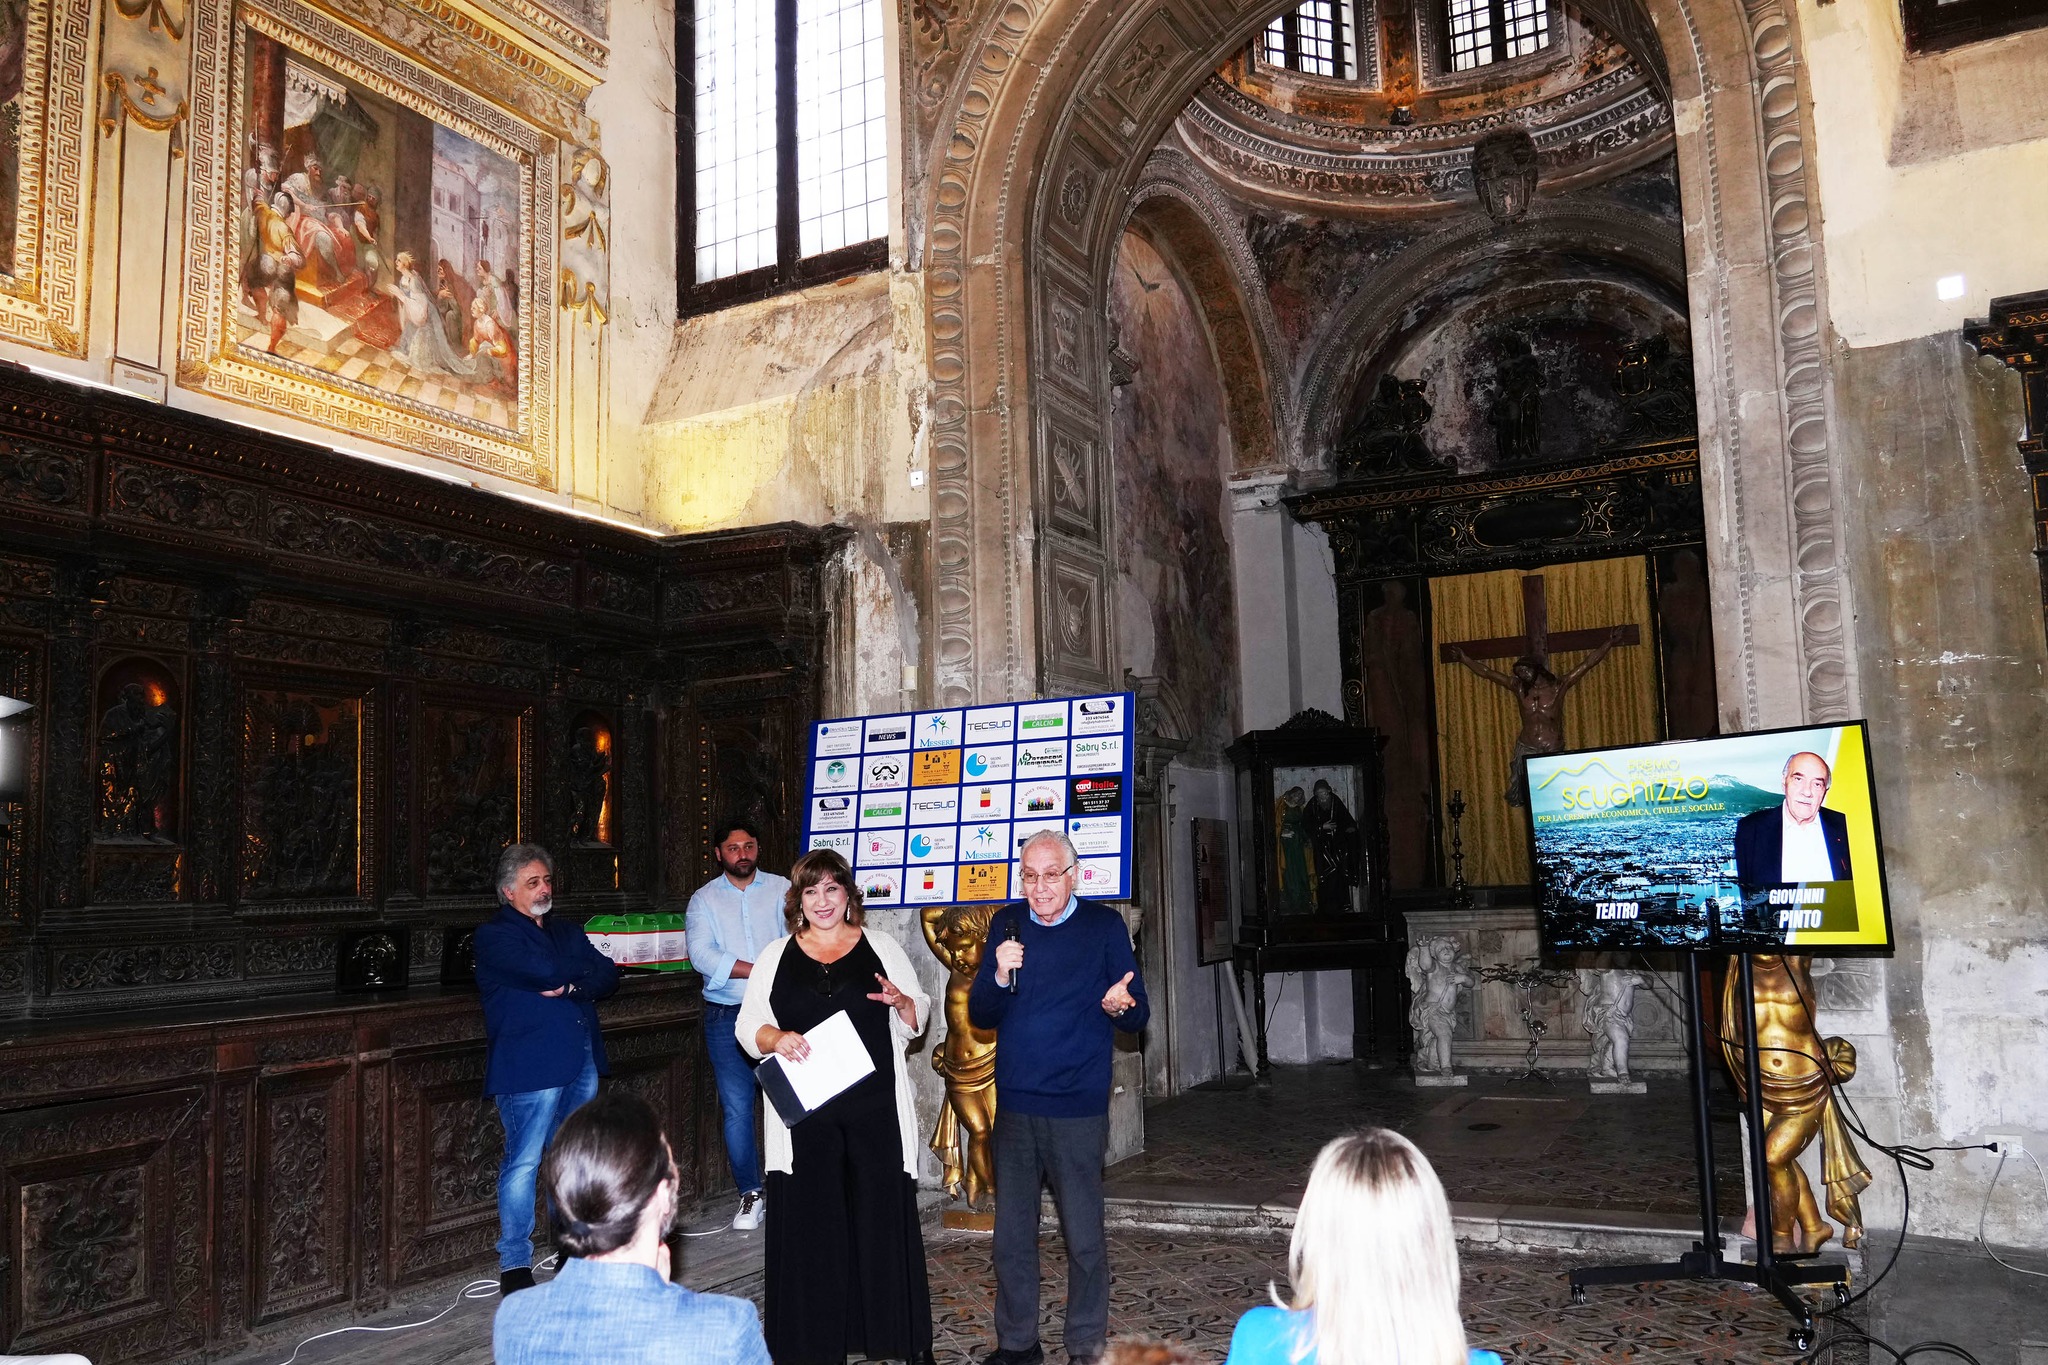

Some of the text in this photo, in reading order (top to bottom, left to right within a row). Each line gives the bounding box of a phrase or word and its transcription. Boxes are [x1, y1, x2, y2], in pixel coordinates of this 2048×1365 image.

[967, 719, 1012, 731] TECSUD
[1031, 720, 1054, 728] CALCIO
[878, 733, 897, 741] NEWS
[919, 738, 955, 748] MESSERE
[1075, 740, 1119, 753] Sabry S.r.l.
[1628, 758, 1680, 772] PREMIO
[1075, 779, 1091, 790] card
[1092, 781, 1115, 789] Italia
[912, 800, 956, 810] TECSUD
[872, 808, 893, 816] CALCIO
[1537, 815, 1552, 823] PER
[1563, 812, 1600, 821] CRESCITA
[1601, 808, 1652, 818] ECONOMICA,
[1652, 805, 1680, 815] CIVILE
[1681, 804, 1688, 813] E
[1688, 802, 1725, 812] SOCIALE
[812, 837, 851, 848] Sabry S.r.l.
[965, 850, 1002, 860] MESSERE
[1769, 888, 1825, 905] GIOVANNI
[1595, 902, 1639, 920] TEATRO
[1779, 909, 1822, 929] PINTO
